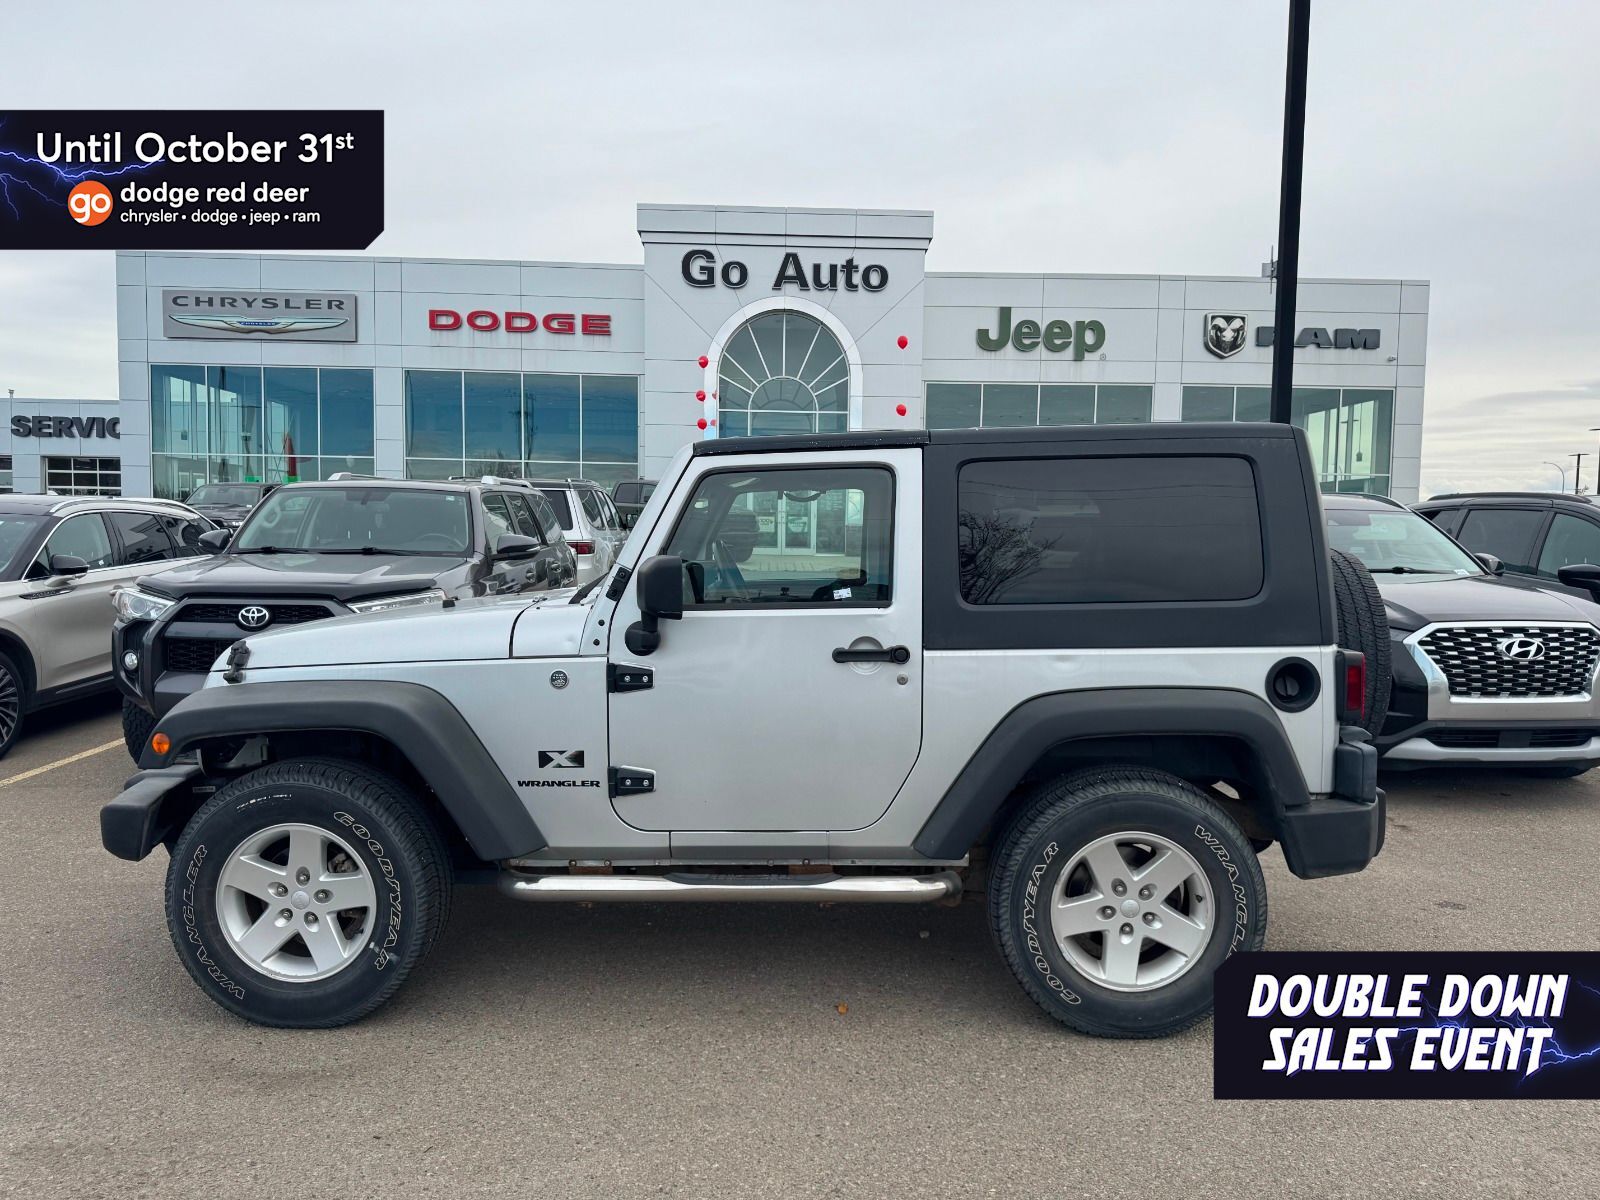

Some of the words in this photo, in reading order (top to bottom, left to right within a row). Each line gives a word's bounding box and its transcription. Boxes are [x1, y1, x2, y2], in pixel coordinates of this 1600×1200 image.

[681, 249, 748, 288] Go
[772, 252, 889, 291] Auto
[171, 295, 345, 311] CHRYSLER
[428, 309, 612, 336] DODGE
[976, 306, 1106, 361] Jeep
[517, 780, 601, 788] WRANGLER
[333, 811, 402, 971] GOODYEAR
[183, 844, 246, 1000] WRANGLER
[1023, 841, 1082, 1006] GOODYEAR
